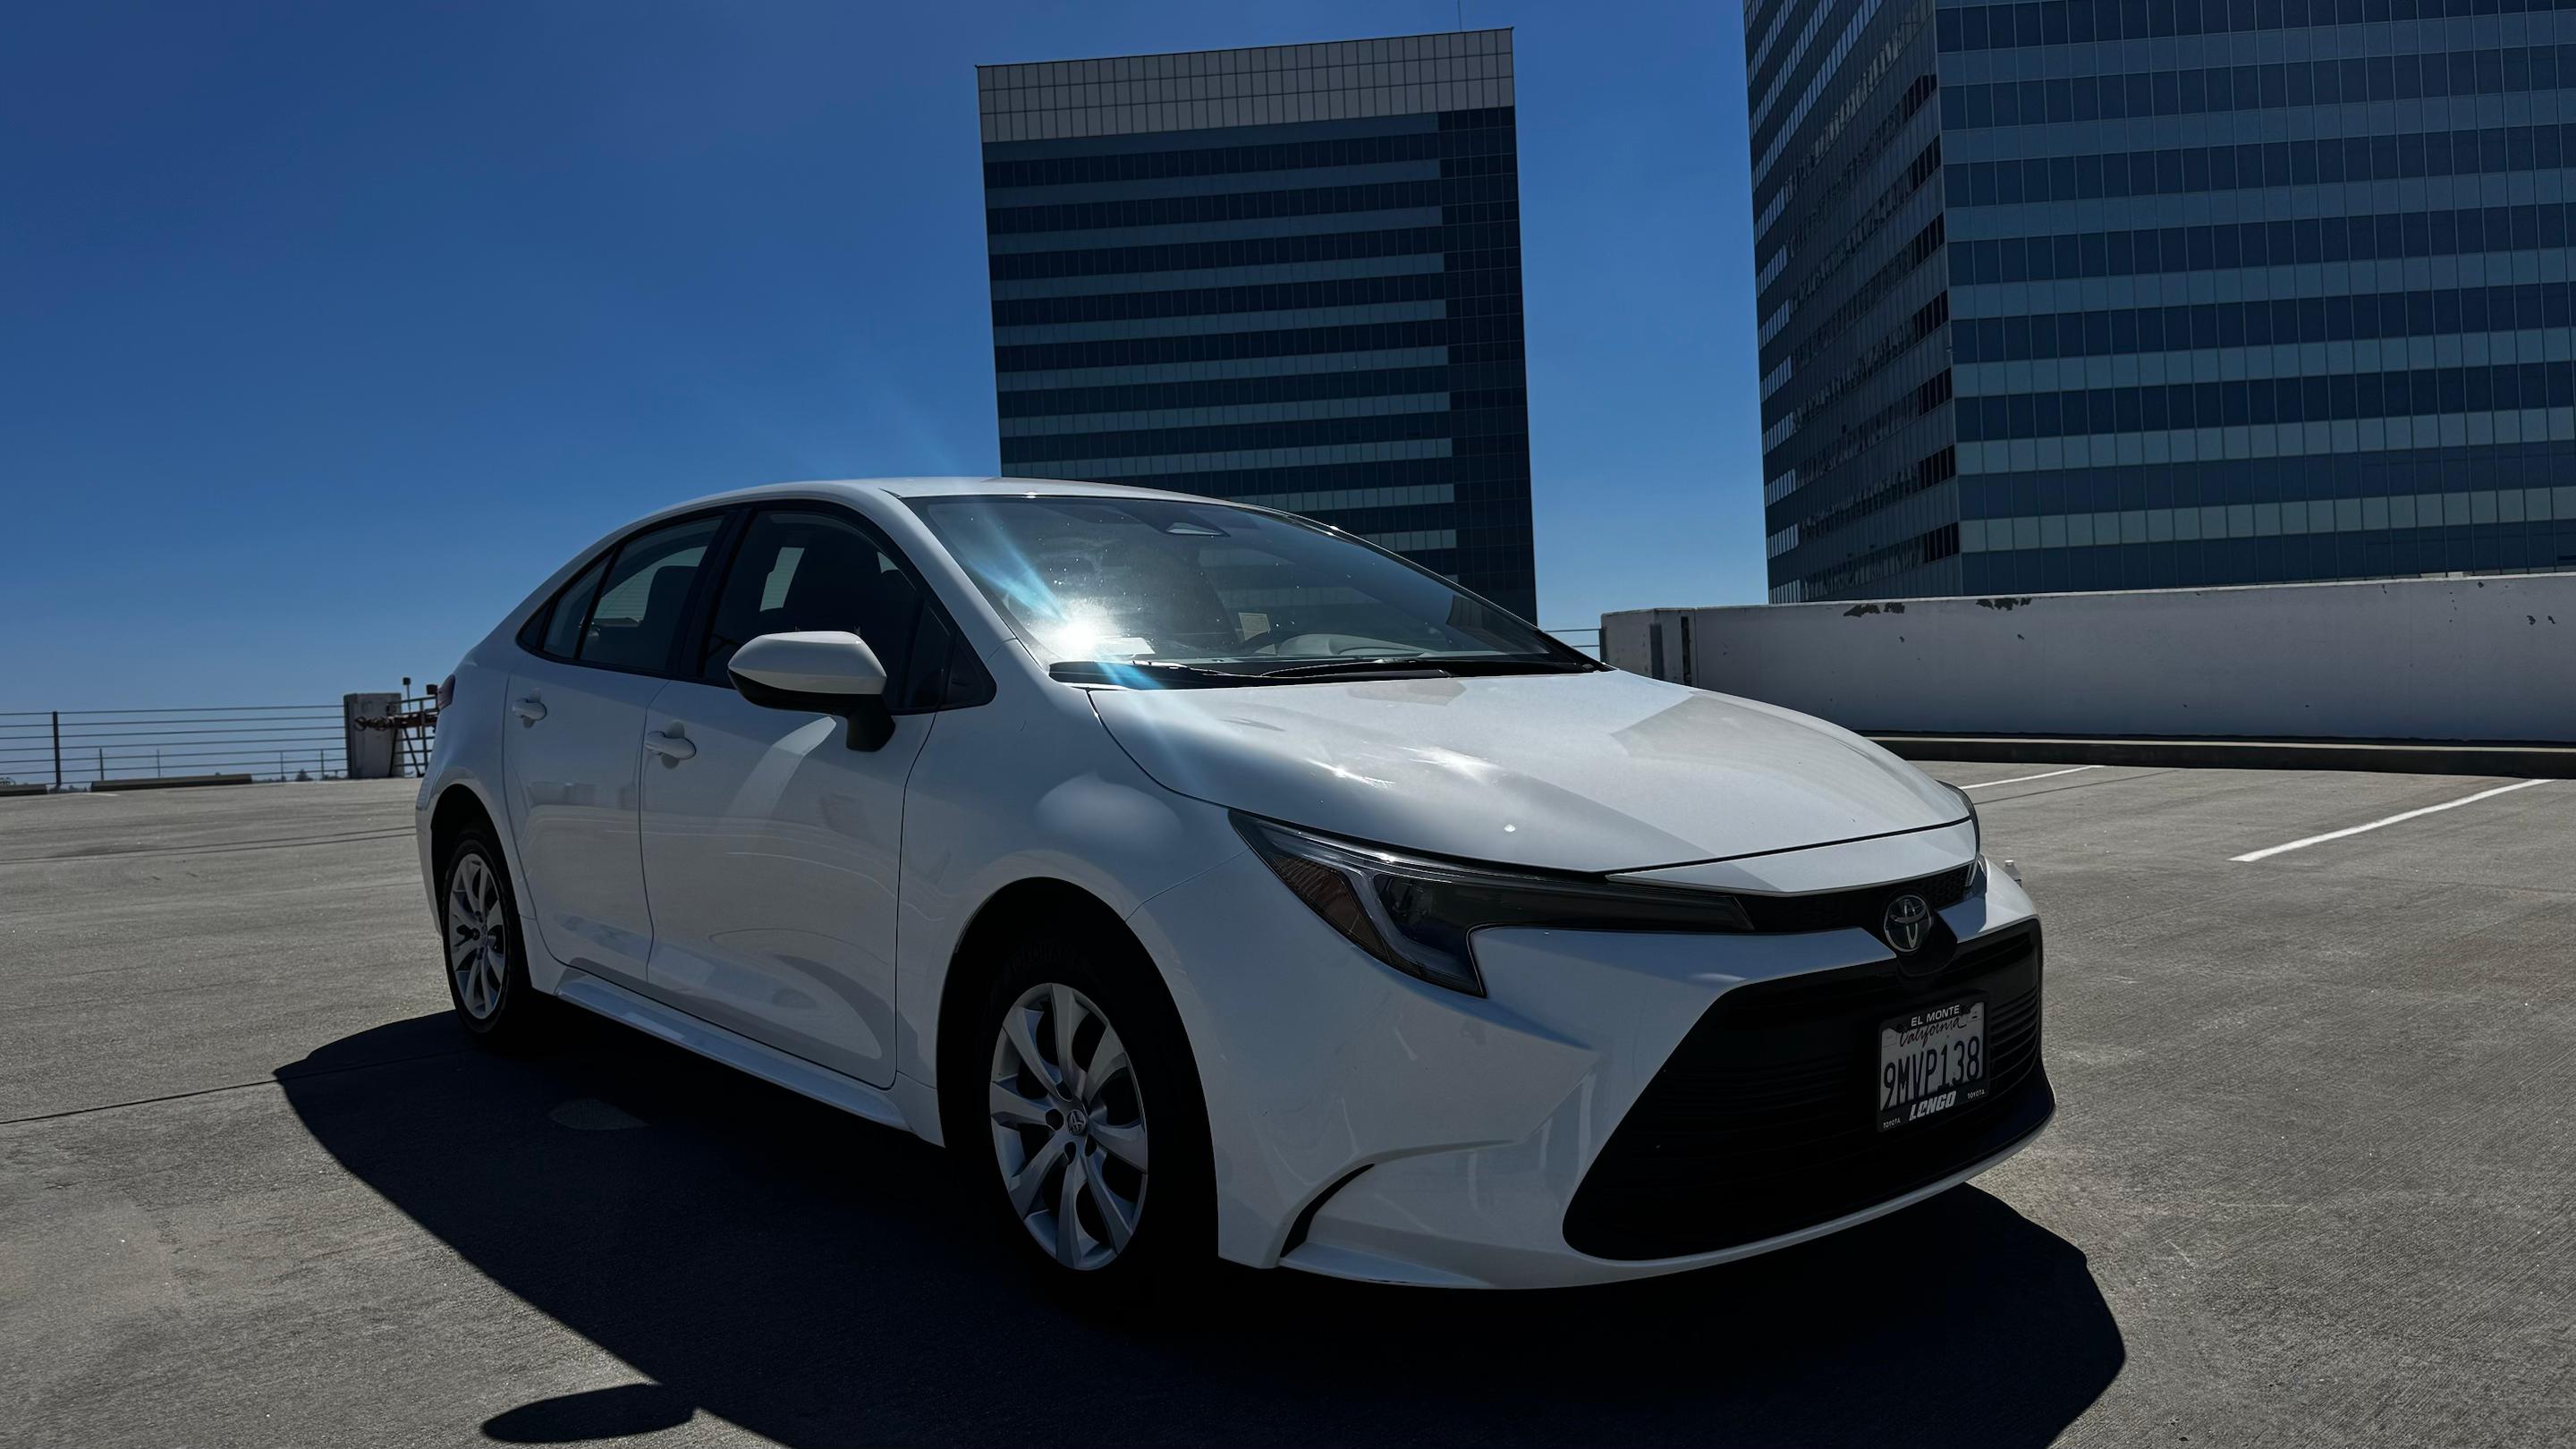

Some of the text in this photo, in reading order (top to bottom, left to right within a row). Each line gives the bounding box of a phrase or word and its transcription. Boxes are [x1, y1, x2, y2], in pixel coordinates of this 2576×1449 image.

[1911, 1004, 1960, 1027] EL MONTE
[1899, 1015, 1967, 1048] California
[1880, 1036, 1980, 1112] 9MVP138
[1909, 1090, 1957, 1121] LONGO
[1968, 1089, 1985, 1099] TOYOTA
[1883, 1117, 1902, 1129] TOYOTA
